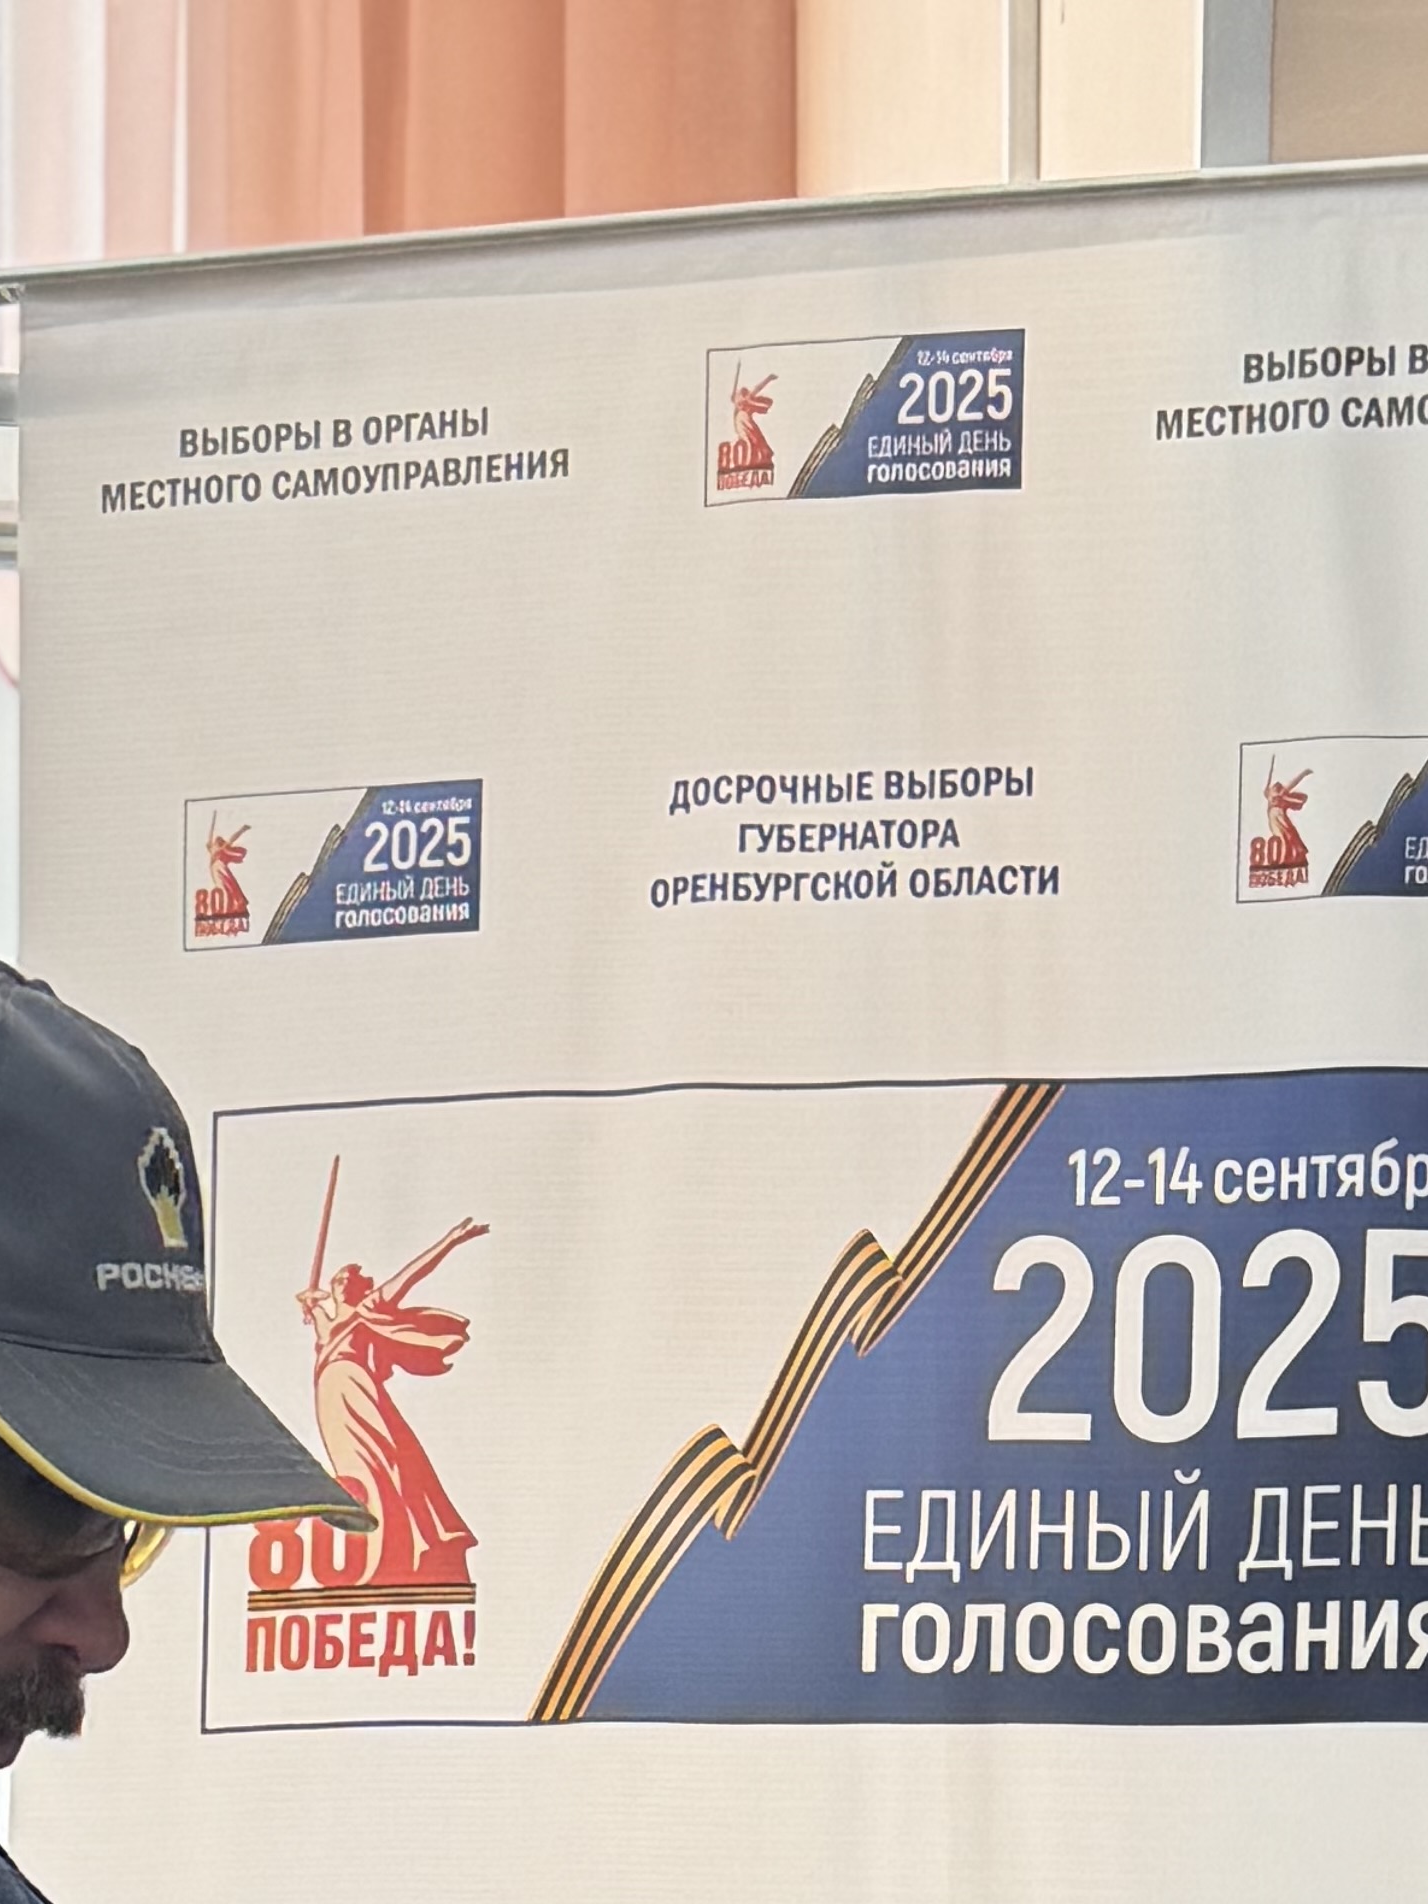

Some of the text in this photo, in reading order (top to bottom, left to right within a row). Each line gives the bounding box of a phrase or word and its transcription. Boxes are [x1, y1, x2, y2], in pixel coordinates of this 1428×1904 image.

[1243, 345, 1396, 384] ВЫБОРЫ
[898, 368, 1012, 424] 2025
[1156, 397, 1330, 441] МЕСТНОГО
[179, 406, 488, 458] ВЫБОРЫ В ОРГАНЫ
[868, 428, 1011, 458] ЕДИНЫЙ ДЕНЬ
[101, 448, 569, 514] МЕСТНОГО САМОУПРАВЛЕНИЯ
[868, 459, 1011, 483] голосования
[669, 766, 1034, 816] ДОСРОЧНЫЕ ВЫБОРЫ
[363, 816, 472, 872] 2025
[738, 818, 960, 853] ГУБЕРНАТОРА
[1249, 836, 1283, 865] 80
[336, 874, 470, 904] ЕДИНЫЙ ДЕНЬ
[650, 860, 1059, 909] ОРЕНБУРГСКОЙ ОБЛАСТИ
[336, 903, 470, 928] голосования
[1069, 1147, 1203, 1207] 12-14
[863, 1468, 1209, 1584] ЕДИНЫЙ
[246, 1610, 476, 1677] ПОБЕДА!
